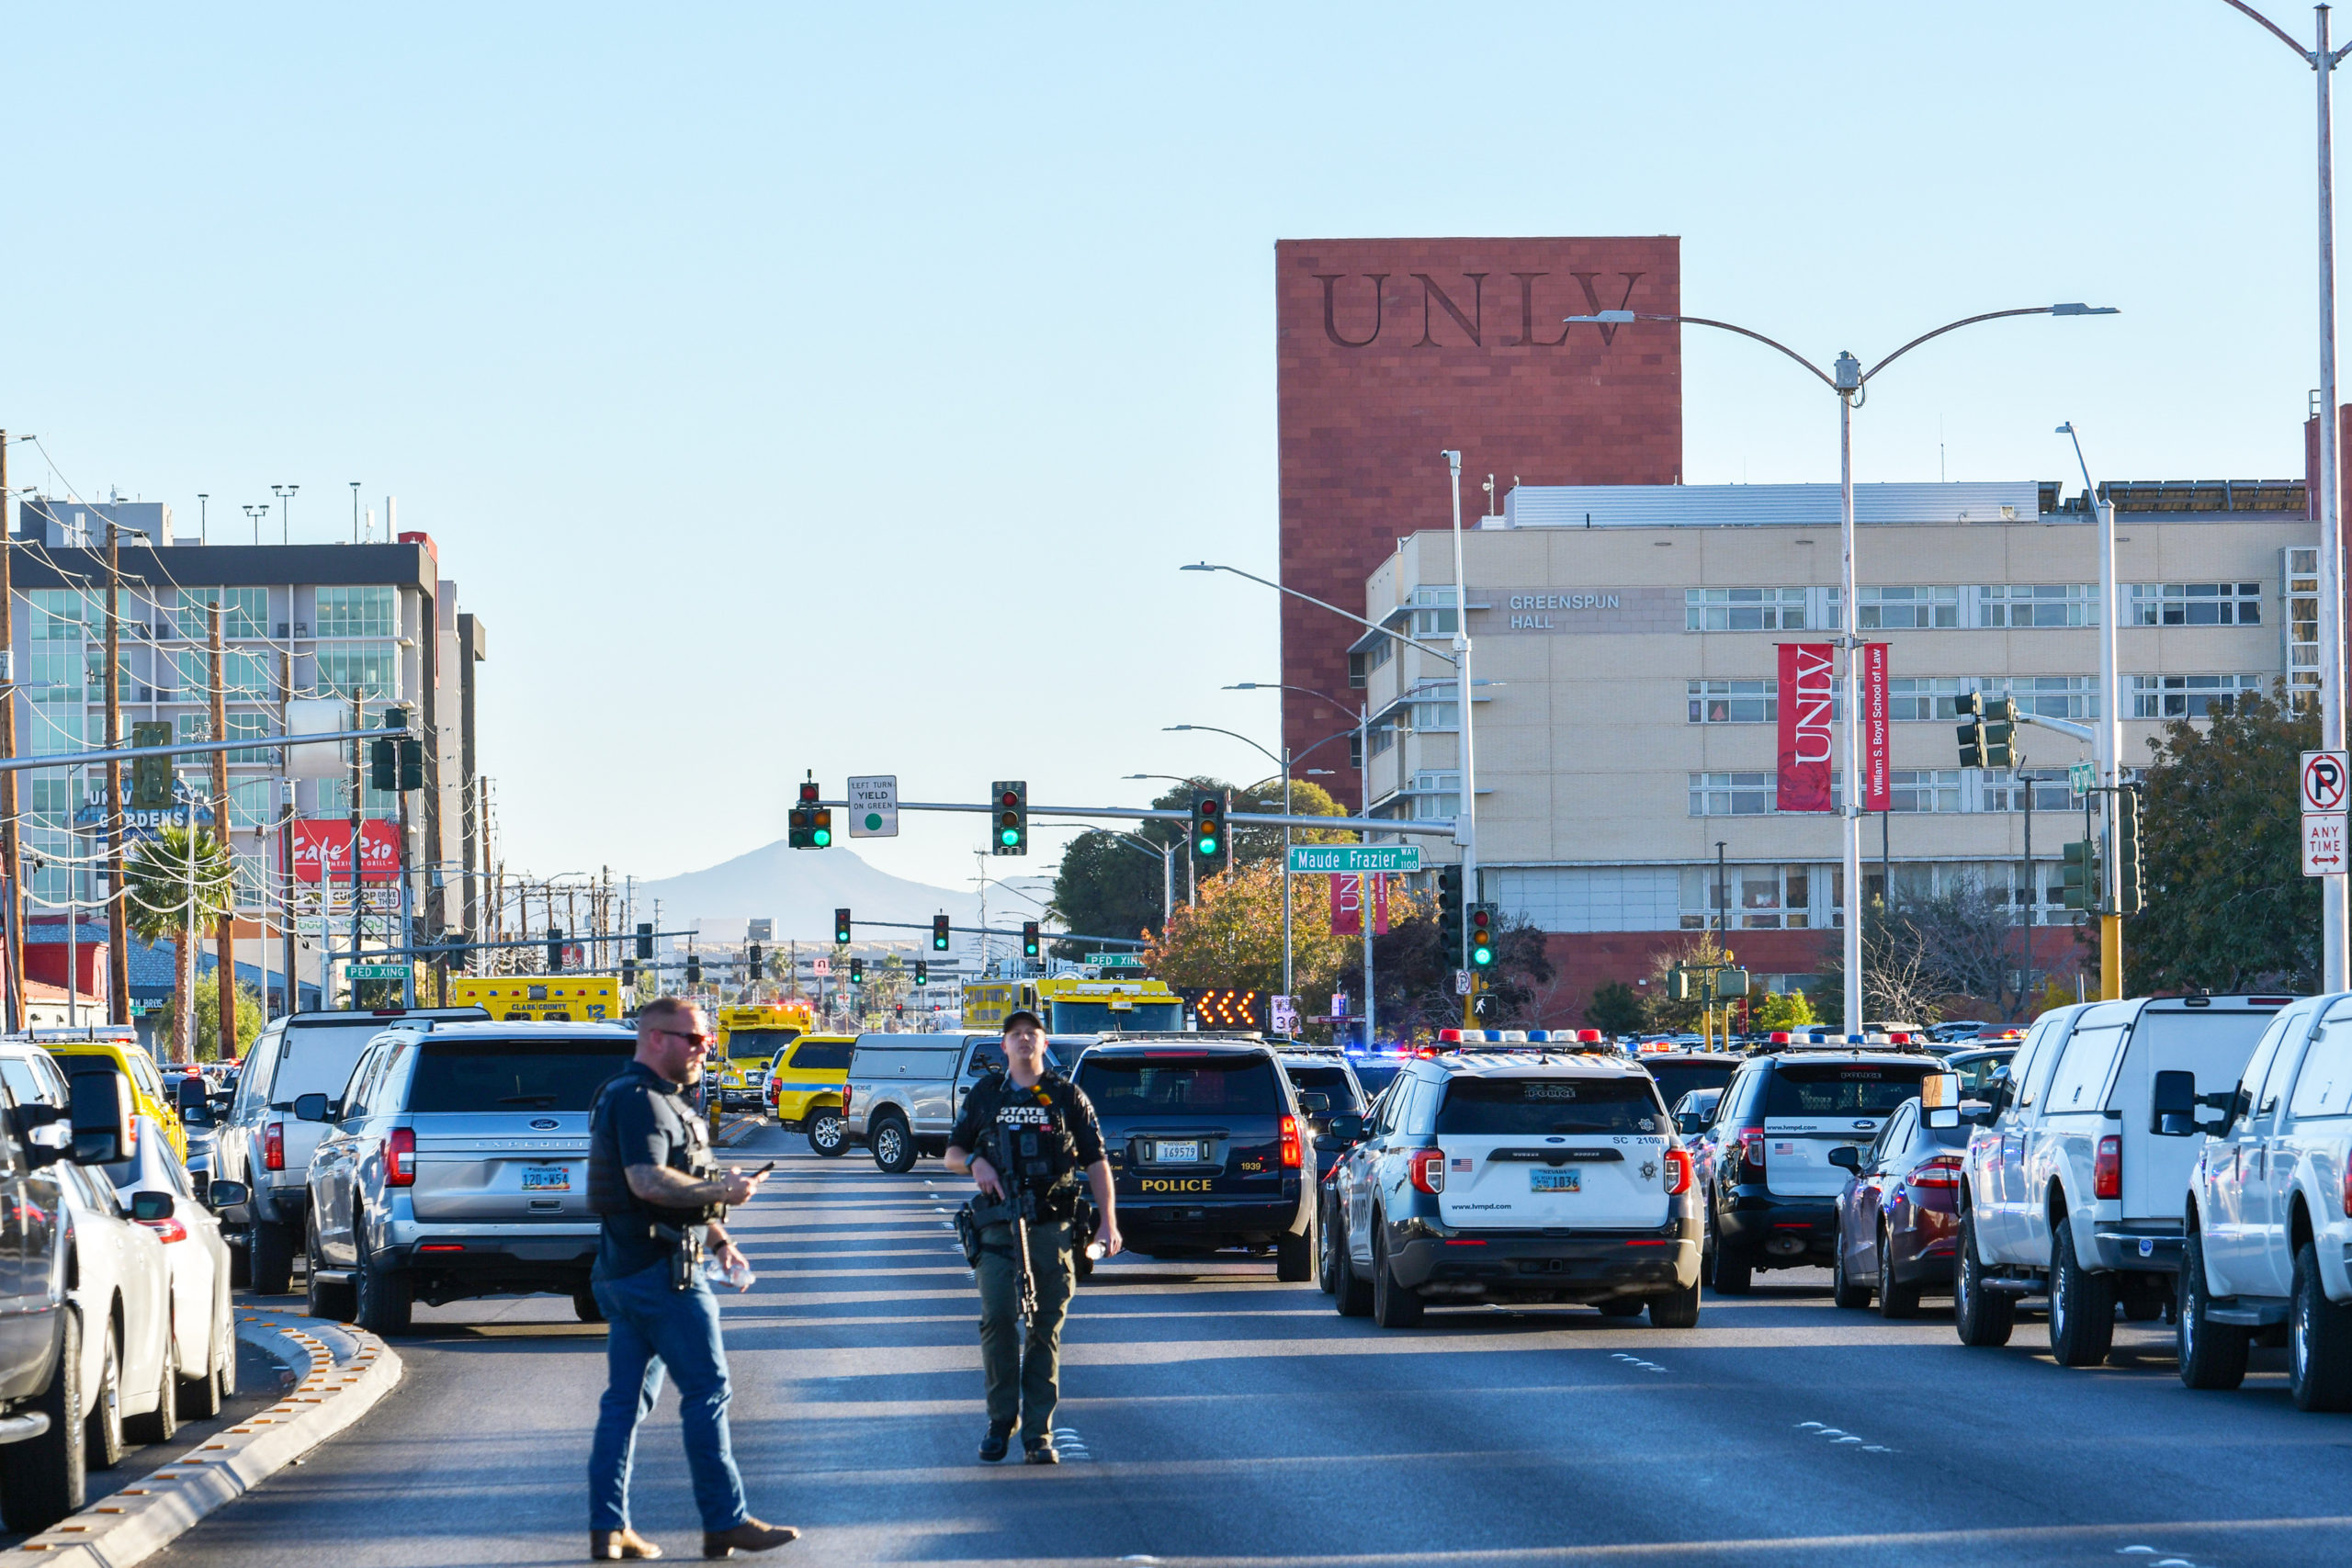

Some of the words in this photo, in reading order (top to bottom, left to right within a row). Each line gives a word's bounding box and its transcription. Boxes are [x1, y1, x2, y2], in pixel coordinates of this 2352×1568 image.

[1312, 272, 1646, 347] UNLV
[1510, 594, 1620, 610] GREENSPUN
[1510, 615, 1555, 629] HALL
[1871, 649, 1882, 670] Law
[1871, 671, 1882, 682] of
[1795, 645, 1834, 768] UNLV
[1871, 683, 1883, 718] School
[1872, 720, 1884, 745] Boyd
[1872, 747, 1883, 757] S.
[1873, 759, 1883, 795] William
[858, 791, 888, 800] YIELD
[99, 812, 184, 827] GRDENS
[2312, 827, 2339, 838] ANY
[2310, 840, 2340, 852] TIME
[1291, 849, 1296, 857] E
[1298, 851, 1340, 868] Maude
[1350, 851, 1396, 868] Frazier
[1401, 861, 1418, 869] 1100
[1091, 956, 1114, 965] PED
[350, 967, 372, 976] PED
[379, 967, 404, 976] XING
[143, 998, 164, 1009] BROS
[585, 1004, 606, 1019] 12
[1000, 1107, 1046, 1115] STATE
[996, 1115, 1048, 1123] POLICE
[1612, 1136, 1629, 1145] SC
[1636, 1136, 1665, 1145] 21007
[1241, 1162, 1261, 1171] 1939
[1142, 1179, 1212, 1191] POLICE
